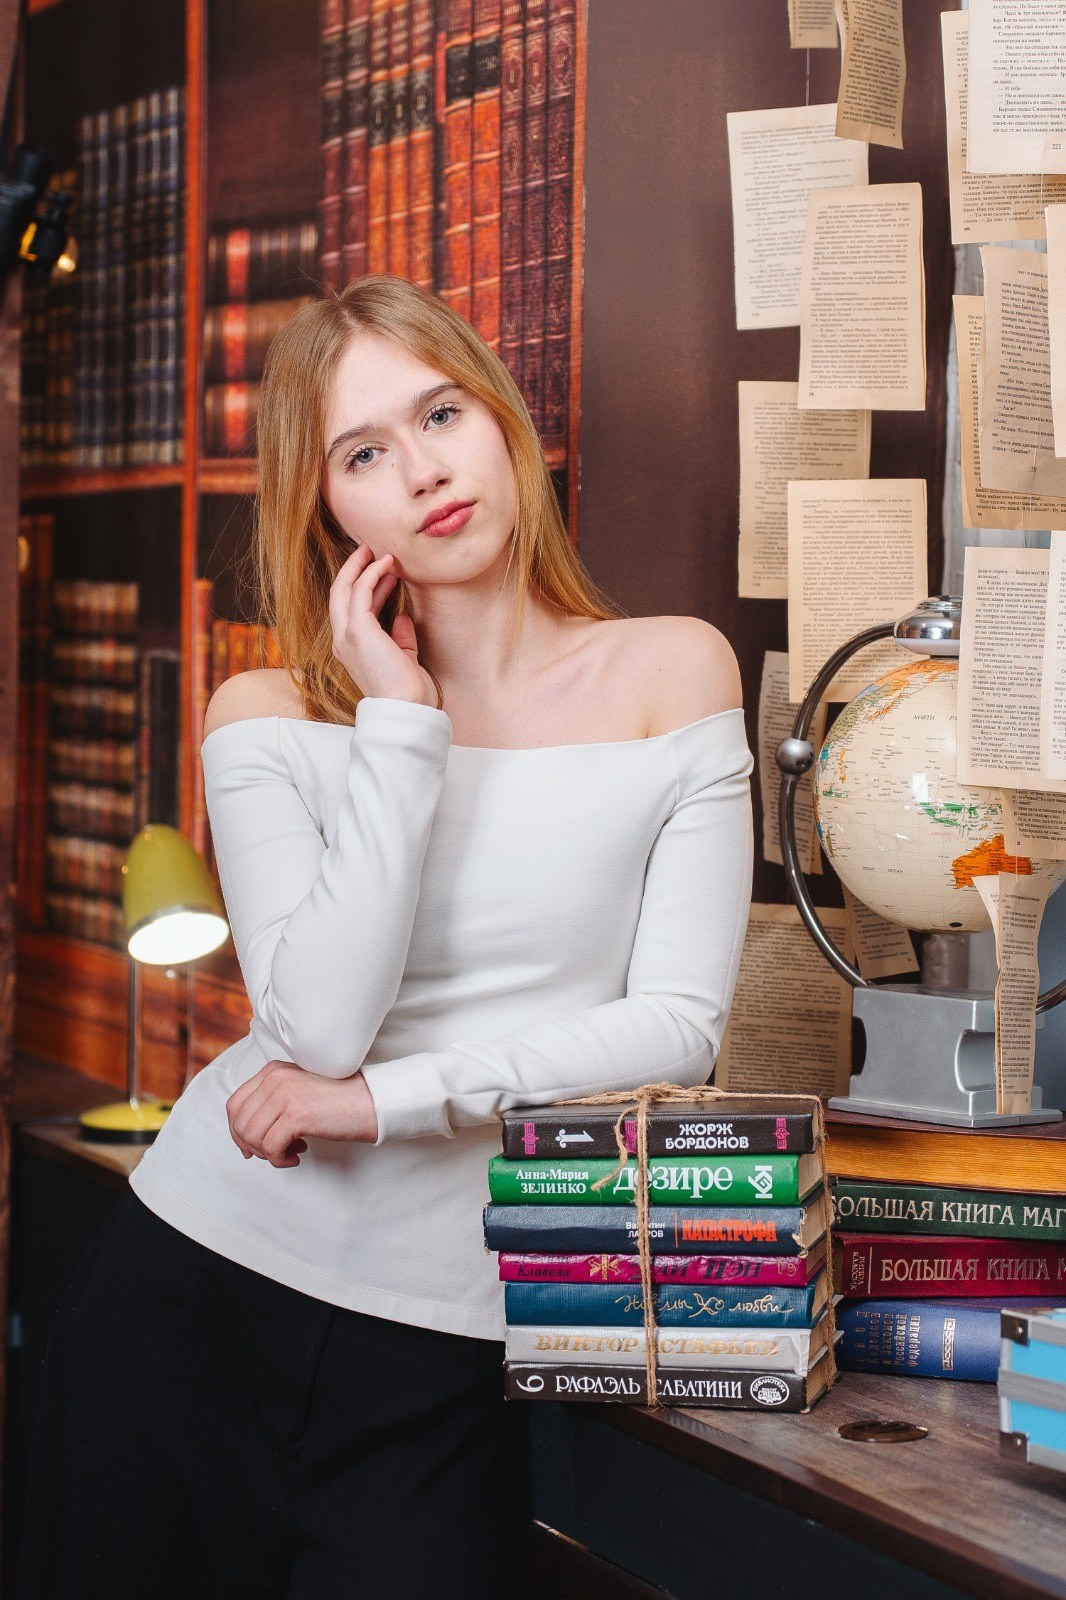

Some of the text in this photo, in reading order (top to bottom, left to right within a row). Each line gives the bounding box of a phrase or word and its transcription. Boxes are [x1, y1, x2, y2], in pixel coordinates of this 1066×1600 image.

[679, 1123, 734, 1136] ЖОРЖ
[665, 1136, 750, 1150] БОРДОНОВ
[520, 1183, 587, 1194] ЗЕЛИНКО
[941, 1201, 1016, 1226] КНИГА
[681, 1219, 778, 1242] КАТАСТРОФА
[518, 1265, 571, 1278] Клавелл
[880, 1258, 980, 1282] БОЛЬШАЯ
[985, 1257, 1051, 1281] КНИГА
[728, 1294, 795, 1313] любви
[533, 1335, 780, 1357] ВИКТОР СТАФЬЕВ
[894, 1313, 908, 1366] Российской
[907, 1315, 921, 1367] Федерации
[555, 1374, 641, 1395] РАФАЭЛЬ
